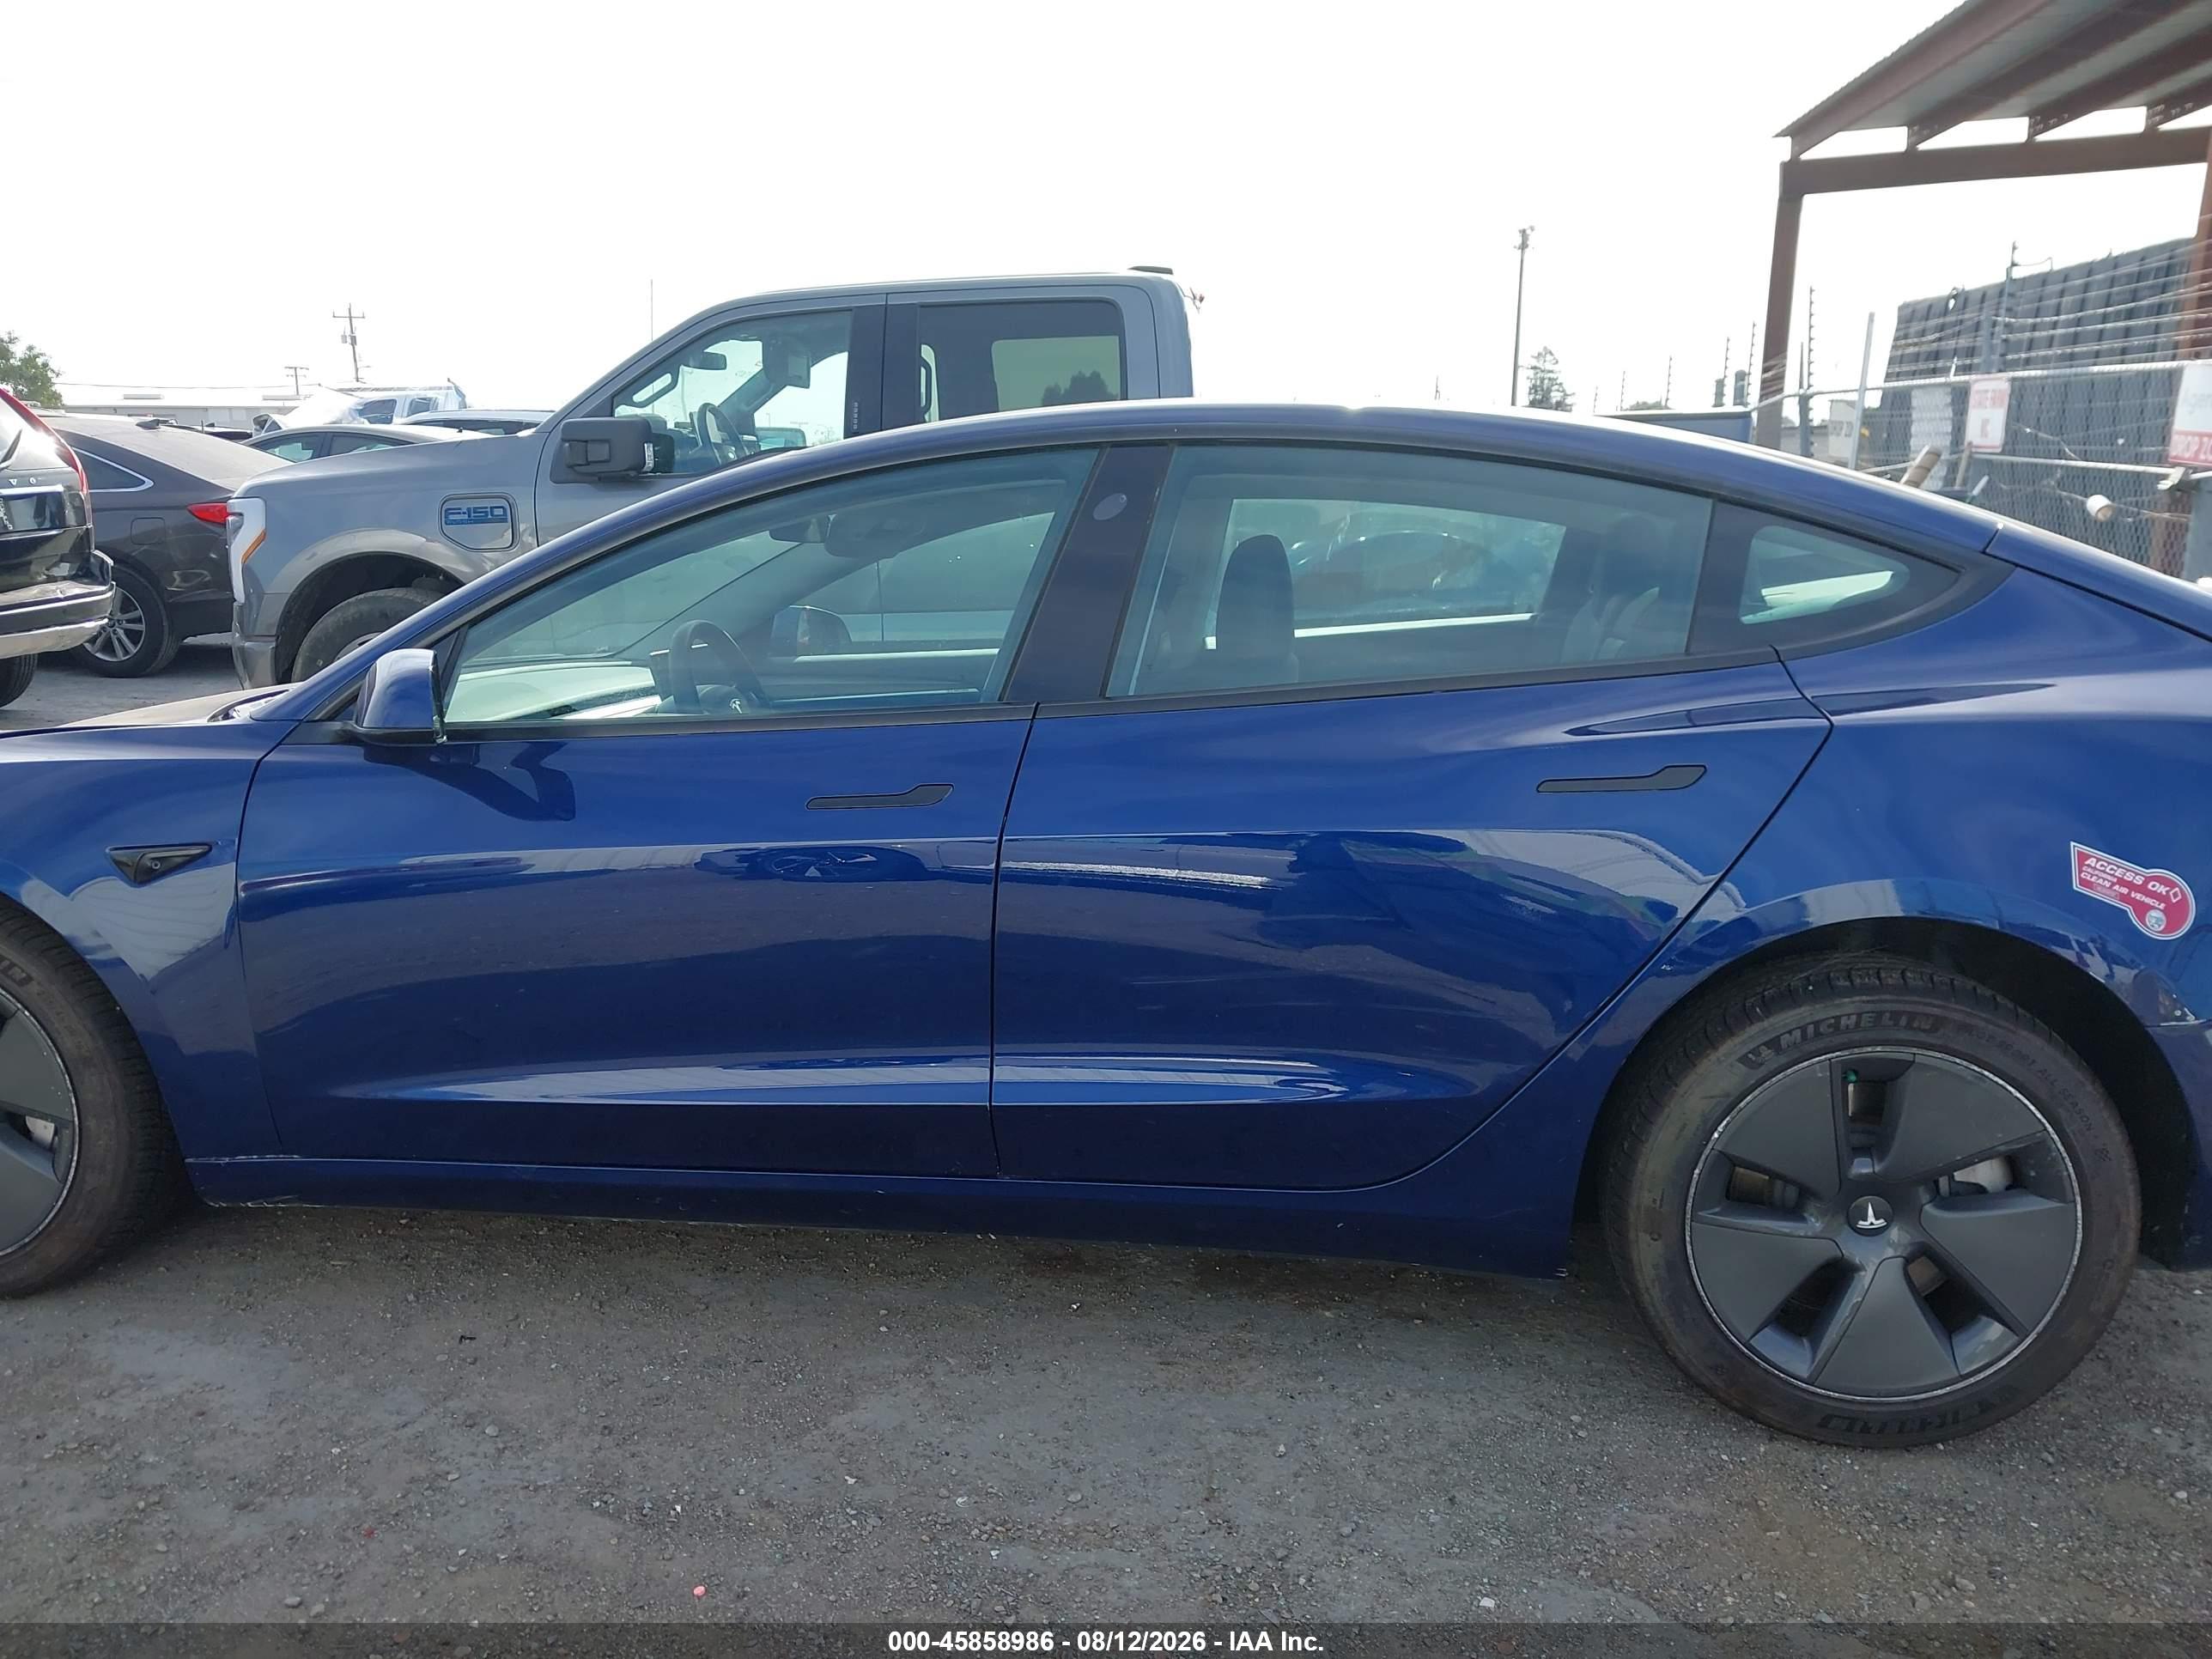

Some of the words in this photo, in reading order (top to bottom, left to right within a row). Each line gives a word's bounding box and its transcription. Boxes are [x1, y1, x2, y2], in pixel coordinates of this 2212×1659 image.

[445, 505, 508, 519] F-150
[2080, 872, 2112, 888] CLEAN
[2113, 884, 2130, 896] AIR
[2130, 890, 2166, 910] VEHICLE
[2081, 866, 2118, 883] CALIFORNIA
[2084, 857, 2146, 885] ACCESS
[2148, 880, 2171, 896] OK
[1780, 1013, 1932, 1048] MICHELIN
